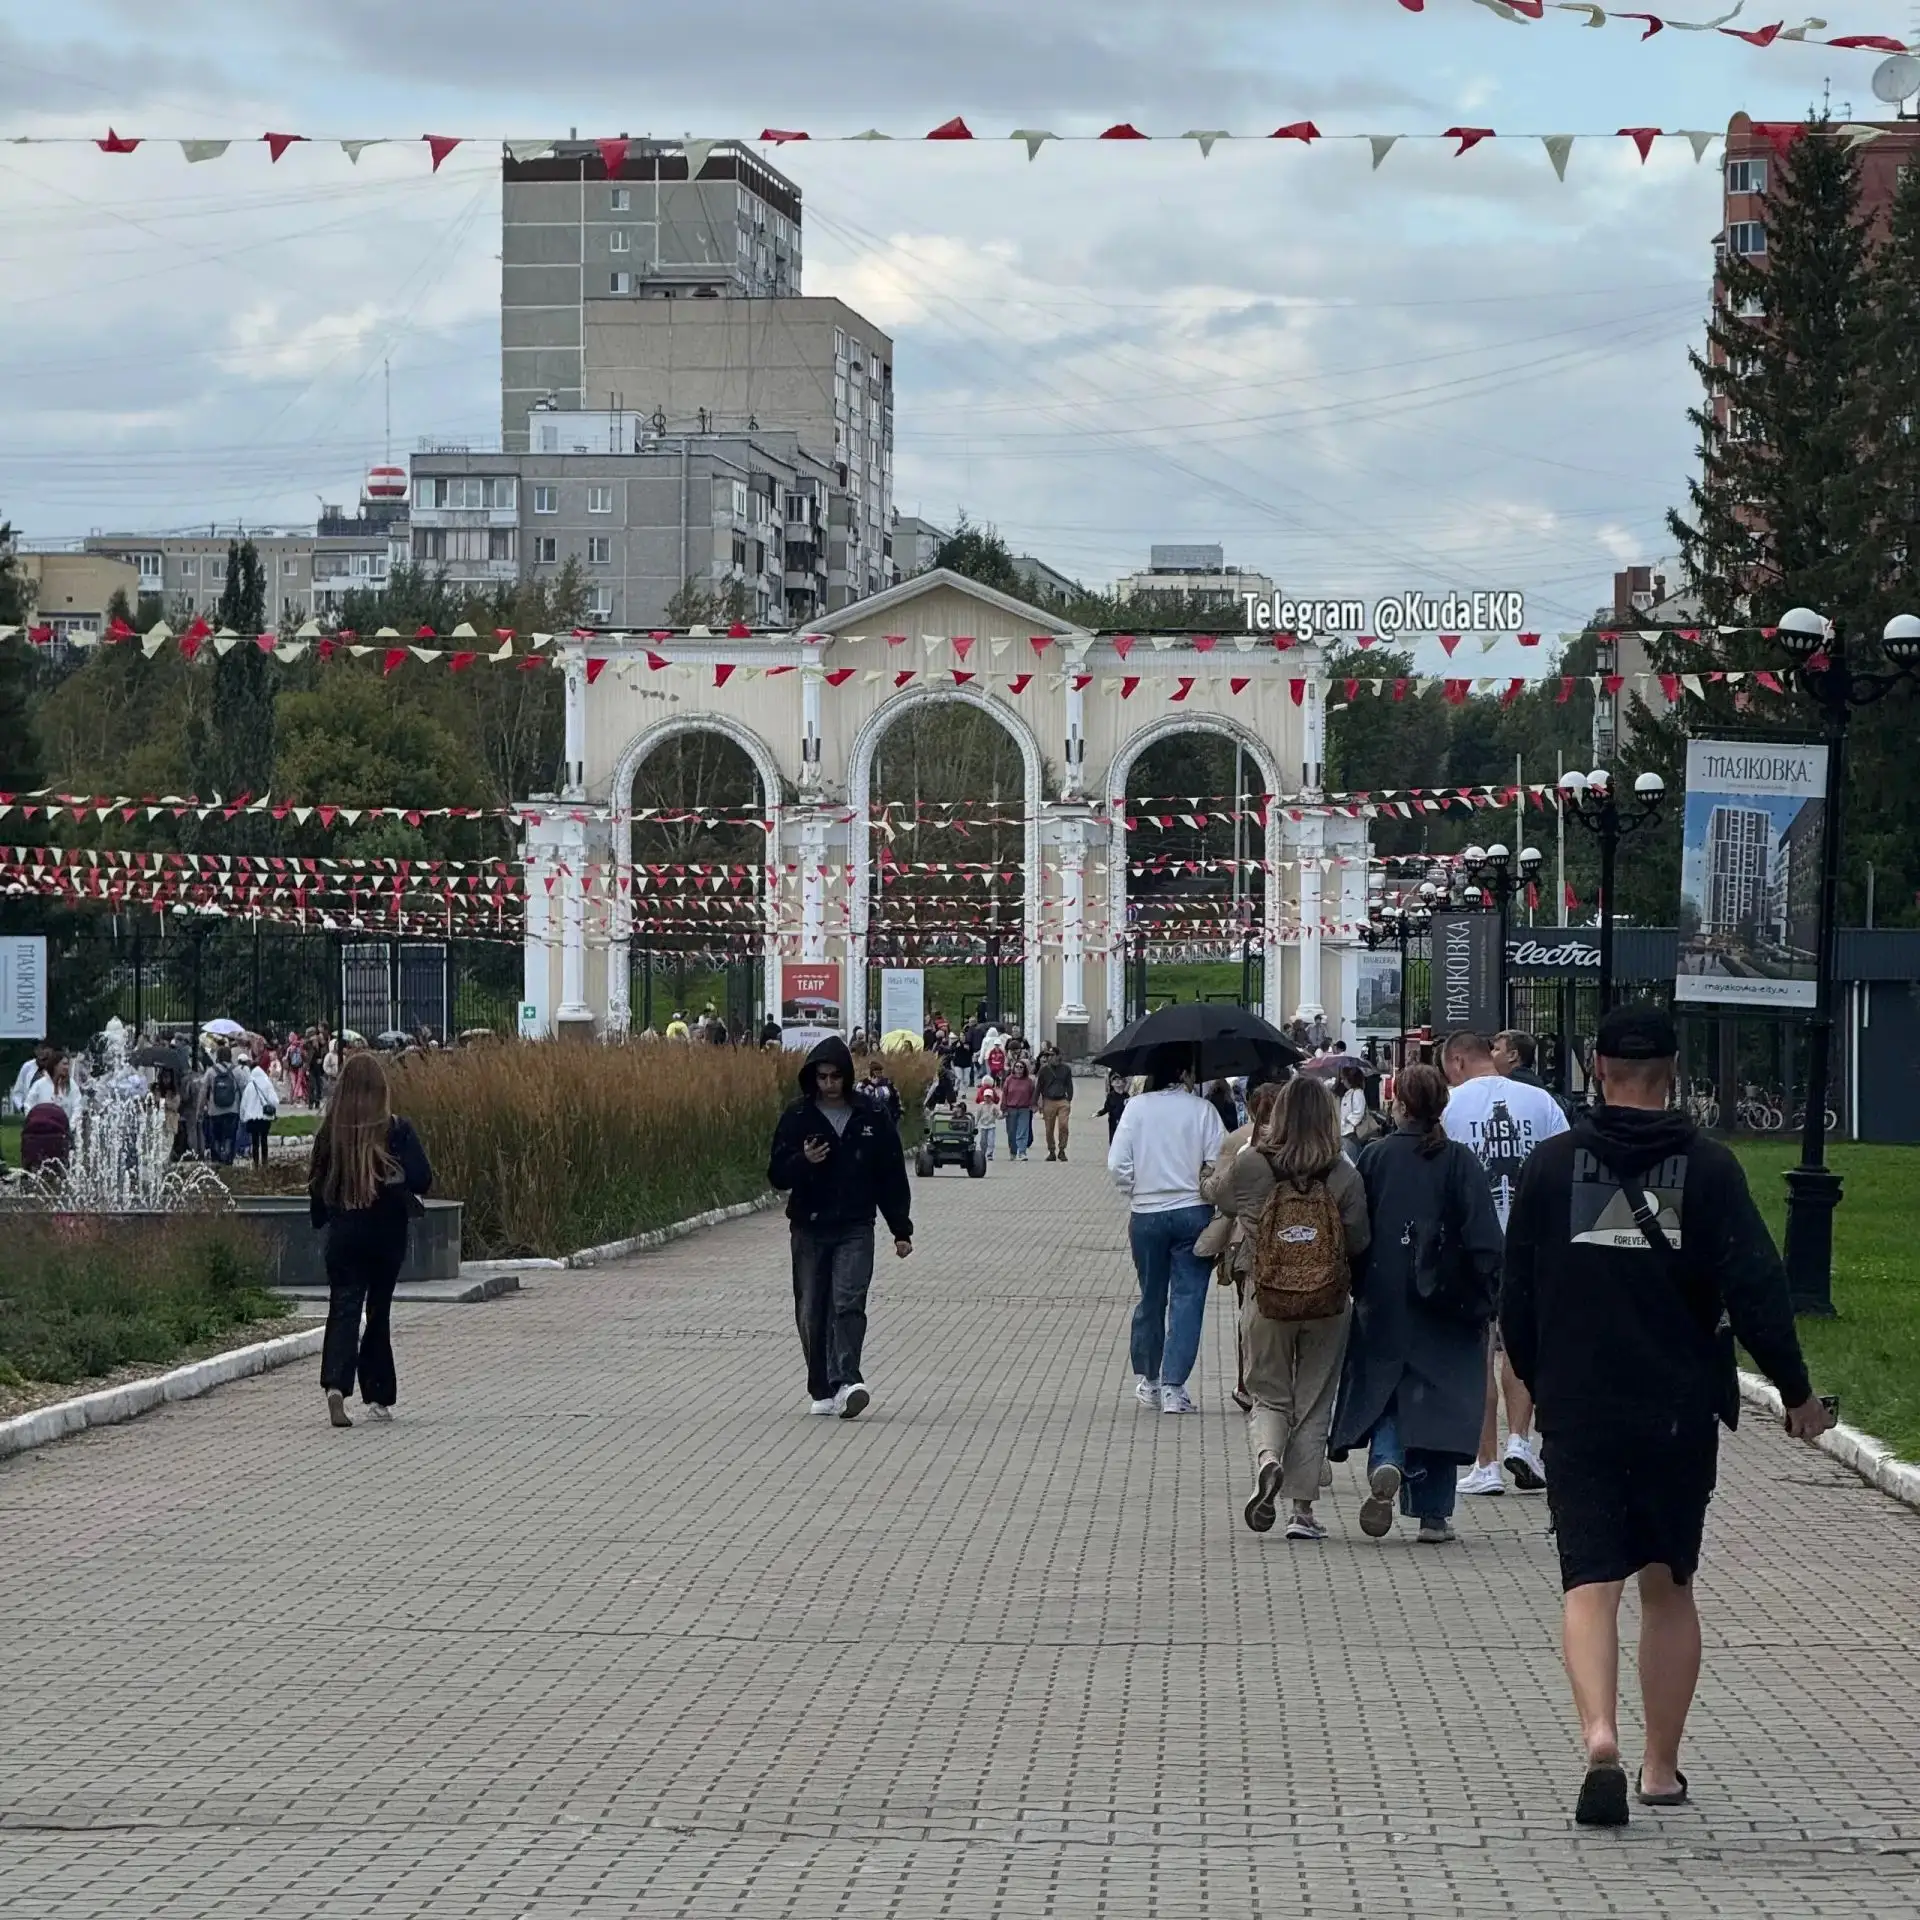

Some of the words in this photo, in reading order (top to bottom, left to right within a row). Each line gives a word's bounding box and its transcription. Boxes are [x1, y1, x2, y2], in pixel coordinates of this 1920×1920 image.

[1706, 755, 1808, 782] МАЯКОВКА
[1445, 920, 1471, 1023] МАЯКОВКА
[797, 979, 825, 991] ТЕАТР
[1470, 1120, 1510, 1138] THIS
[1516, 1119, 1532, 1137] IS
[1488, 1140, 1540, 1158] HOUS
